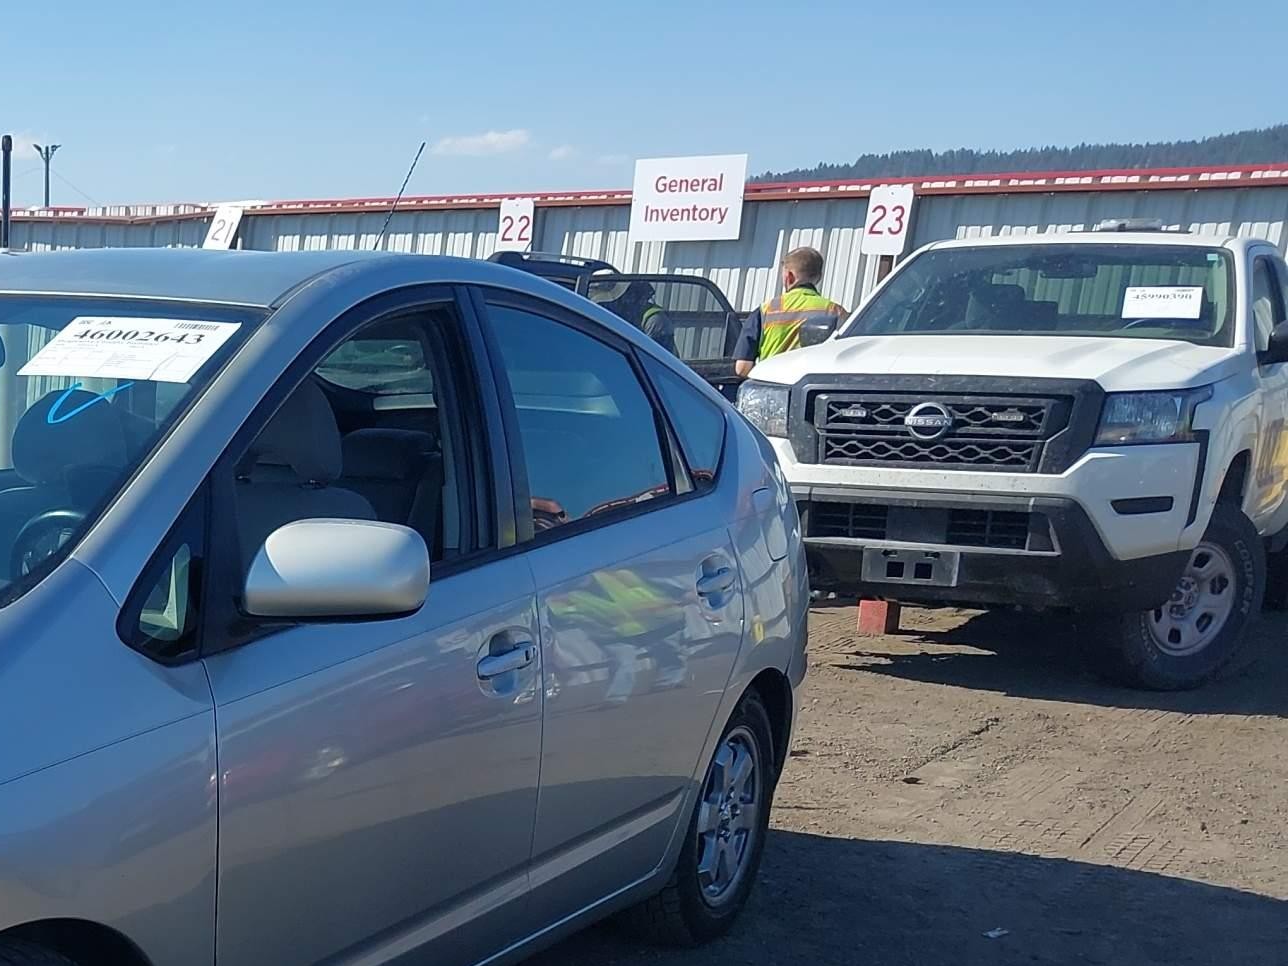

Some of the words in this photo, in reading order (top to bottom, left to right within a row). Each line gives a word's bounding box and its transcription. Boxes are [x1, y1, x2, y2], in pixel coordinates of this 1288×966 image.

[655, 173, 724, 193] General
[644, 204, 728, 224] Inventory
[868, 204, 905, 235] 23
[211, 218, 234, 244] 21
[501, 215, 530, 241] 22
[73, 328, 206, 345] 46002643
[905, 416, 952, 426] NISSAN
